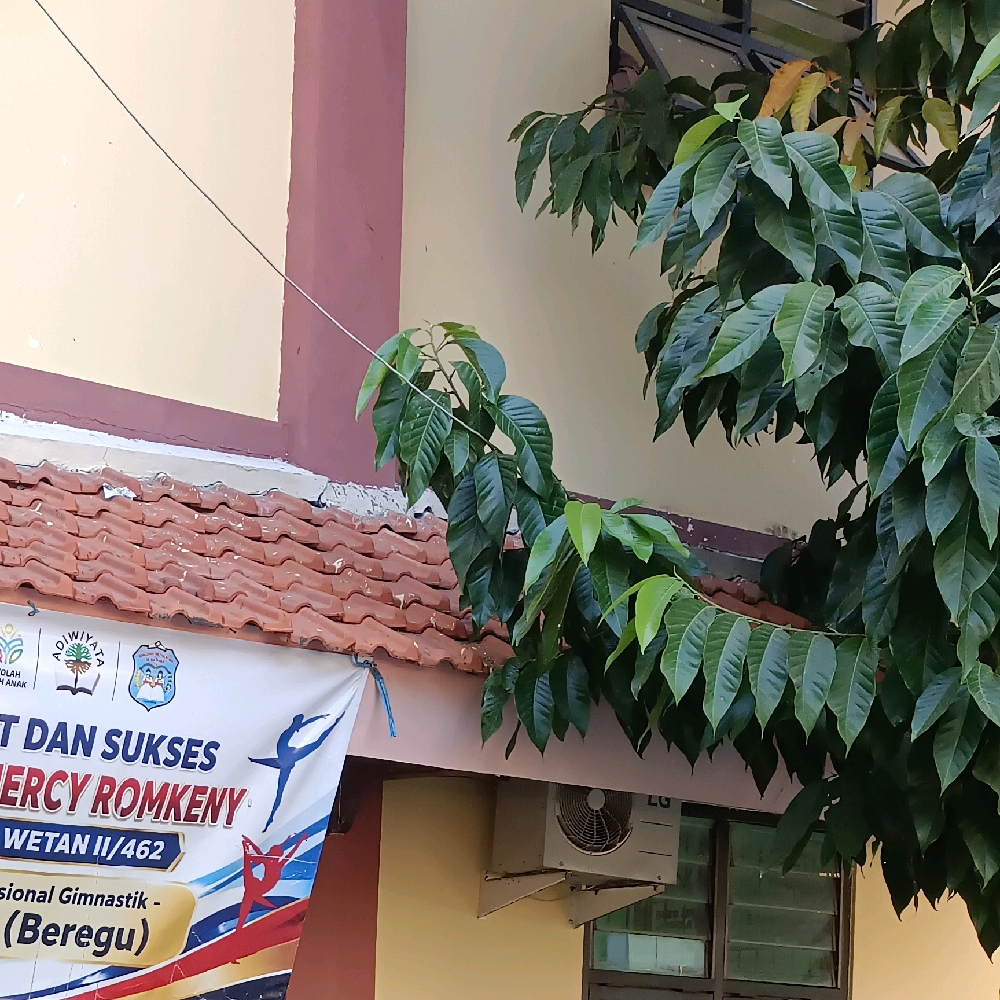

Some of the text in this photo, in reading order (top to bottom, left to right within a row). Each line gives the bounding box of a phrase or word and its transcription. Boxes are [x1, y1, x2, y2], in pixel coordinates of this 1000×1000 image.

[52, 630, 105, 668] ADIWIYATA
[5, 678, 28, 689] ANAK
[24, 717, 97, 757] DAN
[100, 729, 220, 772] SUKSES
[91, 774, 247, 828] ROMKENY
[646, 794, 671, 808] LG
[2, 827, 92, 855] WETAN
[93, 835, 165, 861] II/462
[58, 886, 150, 910] Gimnastik
[3, 909, 149, 957] (Beregu)
